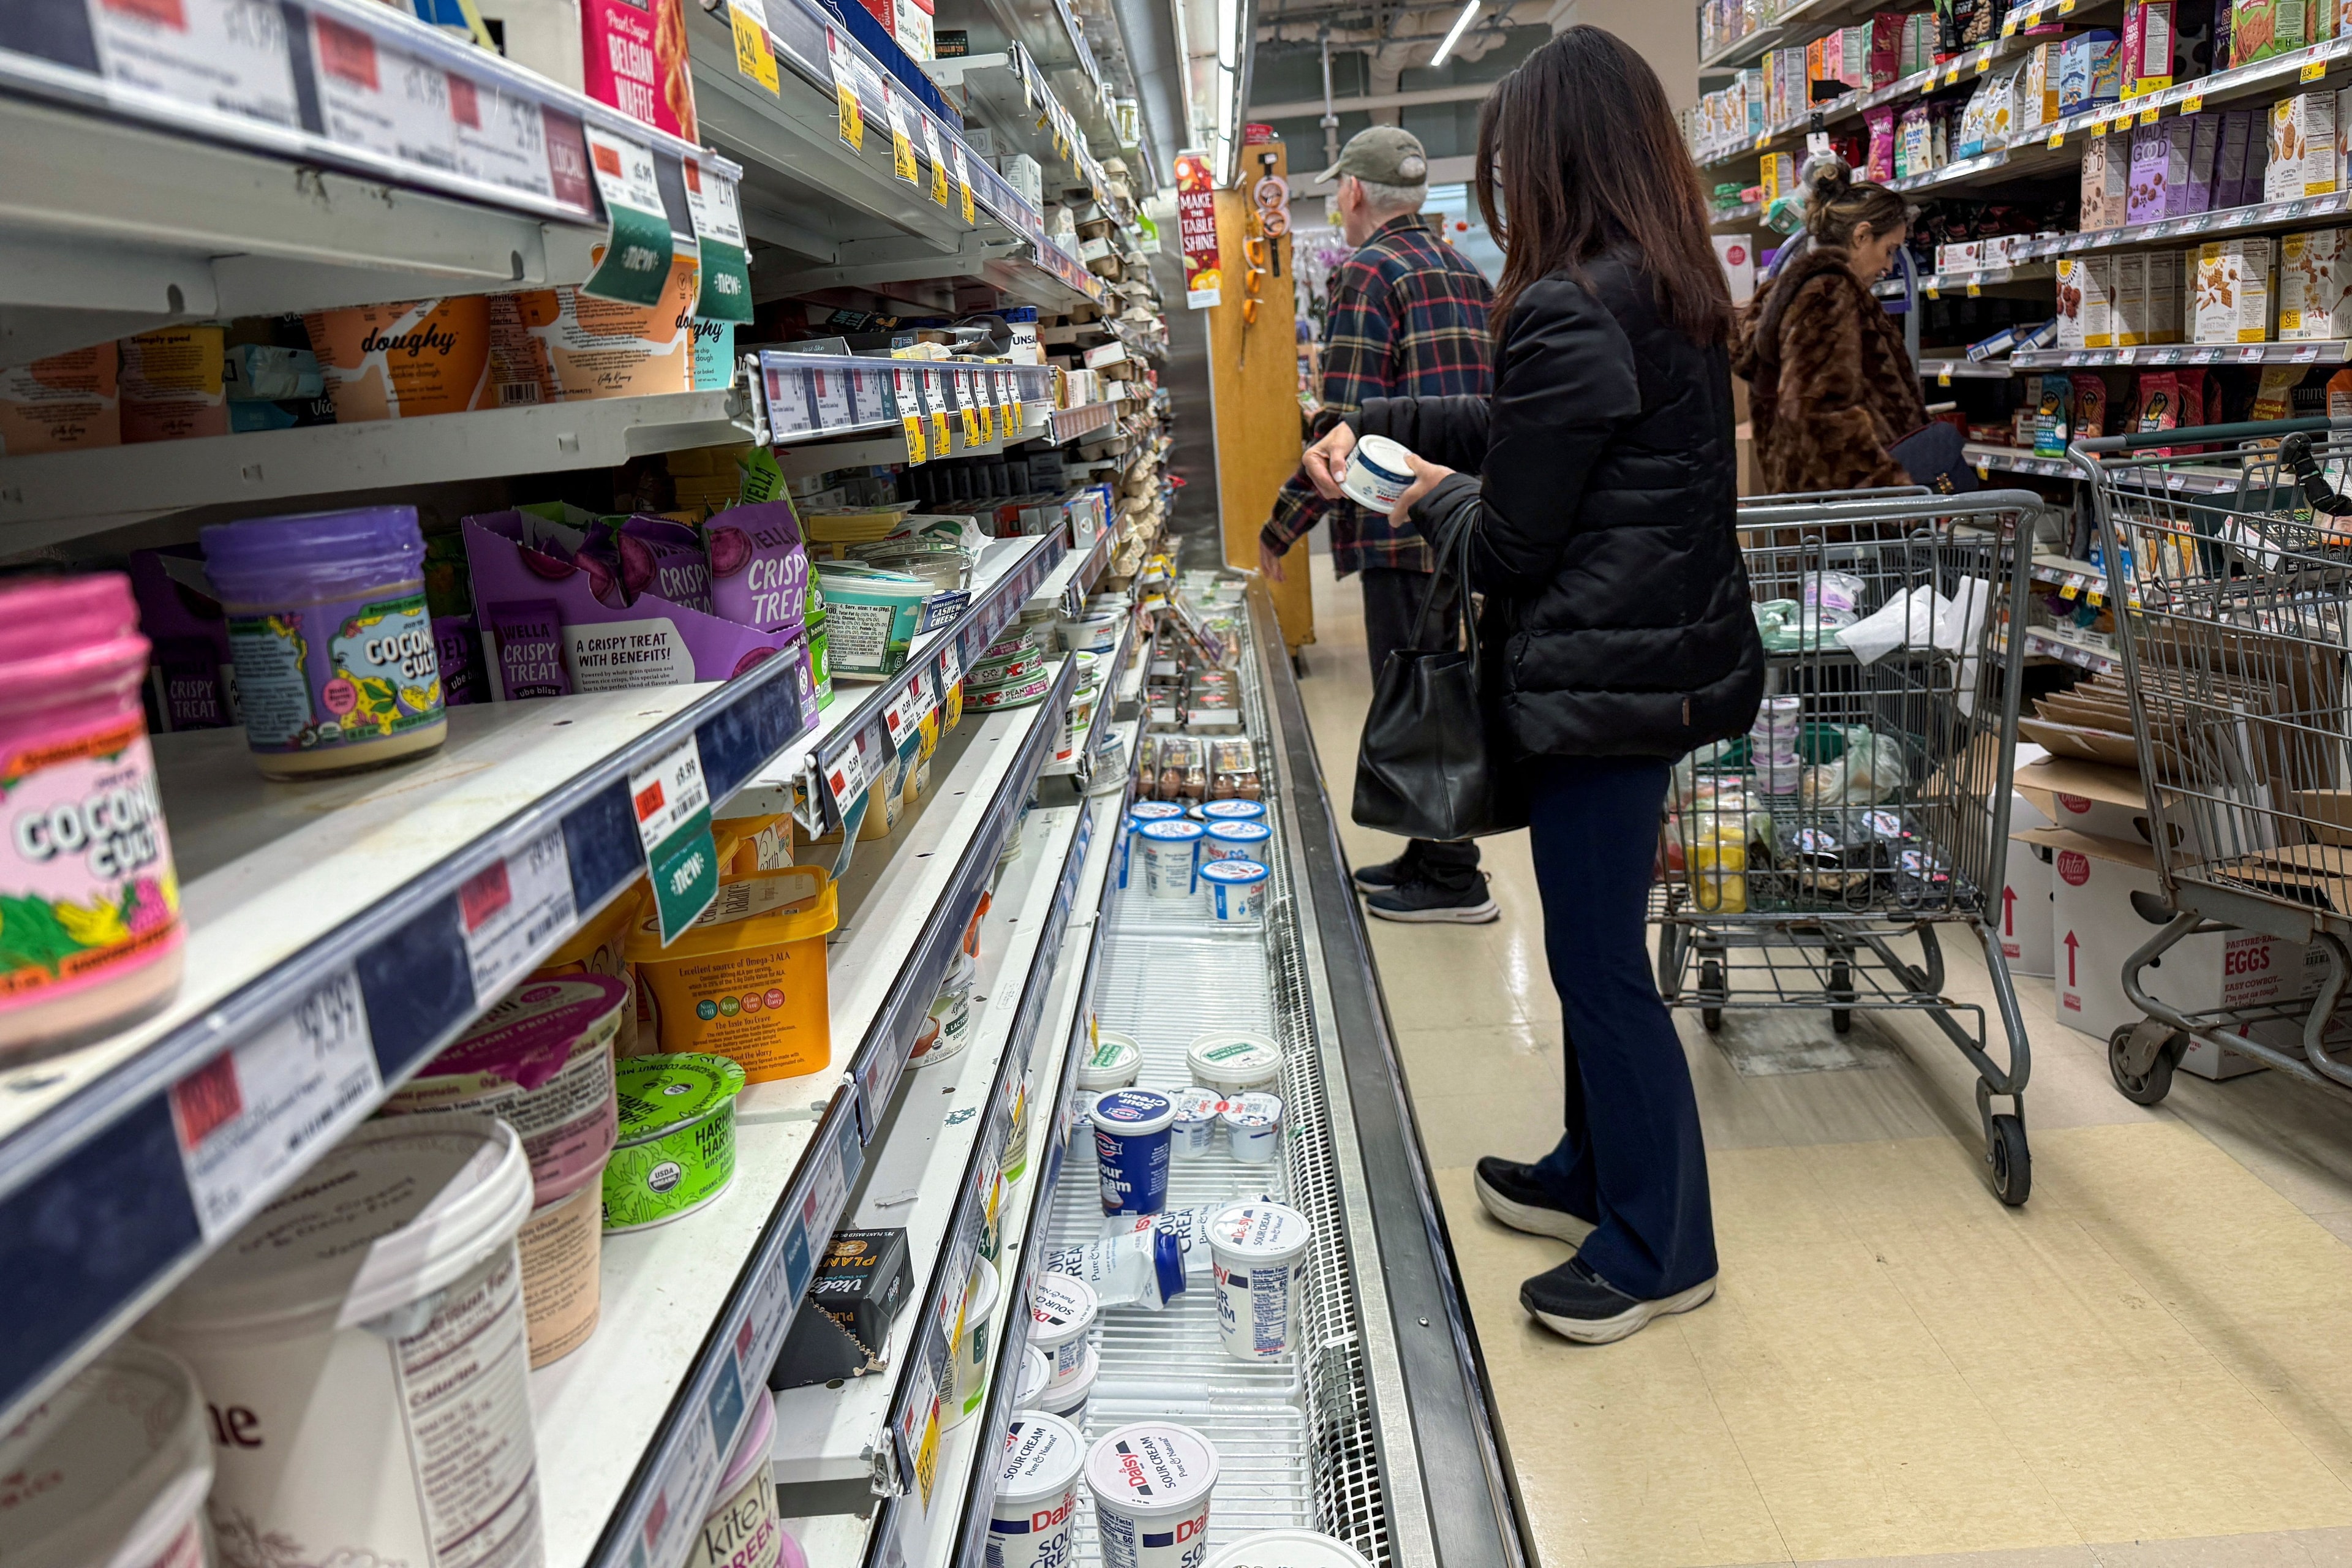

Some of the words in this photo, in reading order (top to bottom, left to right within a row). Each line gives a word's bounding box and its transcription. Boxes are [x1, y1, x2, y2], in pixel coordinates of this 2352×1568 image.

[629, 17, 650, 43] Sugar
[607, 33, 655, 86] BELGIAN
[614, 75, 656, 125] WAFFLE
[2134, 122, 2168, 144] MADE
[2133, 140, 2168, 162] GOOD
[1180, 192, 1213, 210] MAKE
[1182, 217, 1216, 234] TABLE
[1184, 233, 1218, 252] SHINE
[717, 272, 739, 295] new
[167, 334, 190, 344] good
[361, 323, 456, 357] doughy
[696, 353, 714, 363] dough
[659, 563, 711, 598] CRISPY
[748, 554, 809, 592] CRISPY
[944, 596, 968, 606] GOAT-STYLE
[930, 611, 959, 627] CHEESE
[932, 603, 963, 619] CASHEW
[503, 623, 550, 640] WELLA
[810, 626, 824, 637] honey
[576, 640, 583, 653] A
[588, 636, 627, 650] CRISPY
[629, 633, 668, 647] TREAT
[503, 642, 556, 663] CRISPY
[579, 654, 607, 667] WITH
[611, 647, 671, 666] BENEFITS!
[508, 661, 559, 682] TREAT
[519, 688, 535, 697] ube
[537, 685, 556, 695] bliss
[609, 683, 627, 692] perfect
[1005, 687, 1028, 698] PLANT
[847, 754, 859, 775] $2.99
[673, 852, 703, 895] new
[2059, 856, 2086, 874] Vital
[720, 883, 751, 916] balance
[679, 965, 711, 977] Excellent
[712, 963, 735, 971] source
[737, 959, 744, 968] of
[746, 954, 775, 966] Omega-3
[775, 952, 790, 961] ALA
[2225, 946, 2270, 976] EGGS
[2225, 982, 2245, 992] EASY
[2259, 985, 2279, 997] tough
[720, 1001, 739, 1012] Vegan
[767, 998, 783, 1006] Dairy
[516, 1006, 582, 1031] PROTEIN
[744, 1017, 754, 1026] You
[754, 1015, 771, 1024] Crave
[464, 1029, 516, 1052] PLANT
[756, 1049, 773, 1059] Worry
[1118, 1092, 1167, 1107] Cream
[1118, 1099, 1153, 1110] Sour
[654, 1166, 674, 1179] USDA
[699, 1177, 719, 1195] ORGANIC
[1258, 1212, 1273, 1229] CREAM
[1254, 1227, 1265, 1246] SOUR
[820, 1255, 877, 1268] PLAN
[1091, 1259, 1101, 1282] Pure
[1279, 1280, 1287, 1288] 60
[1044, 1298, 1075, 1316] SOUR
[1060, 1293, 1076, 1305] Pure
[1021, 1427, 1047, 1458] CREAM
[1139, 1436, 1164, 1467] CREAM
[1003, 1455, 1027, 1480] SOUR
[1025, 1461, 1040, 1476] Pure
[1116, 1453, 1148, 1488] Daisy
[1155, 1464, 1177, 1489] SOUR
[1176, 1463, 1188, 1478] Pure
[1115, 1513, 1132, 1527] Facts
[704, 1498, 758, 1565] kite
[1123, 1535, 1133, 1545] 60
